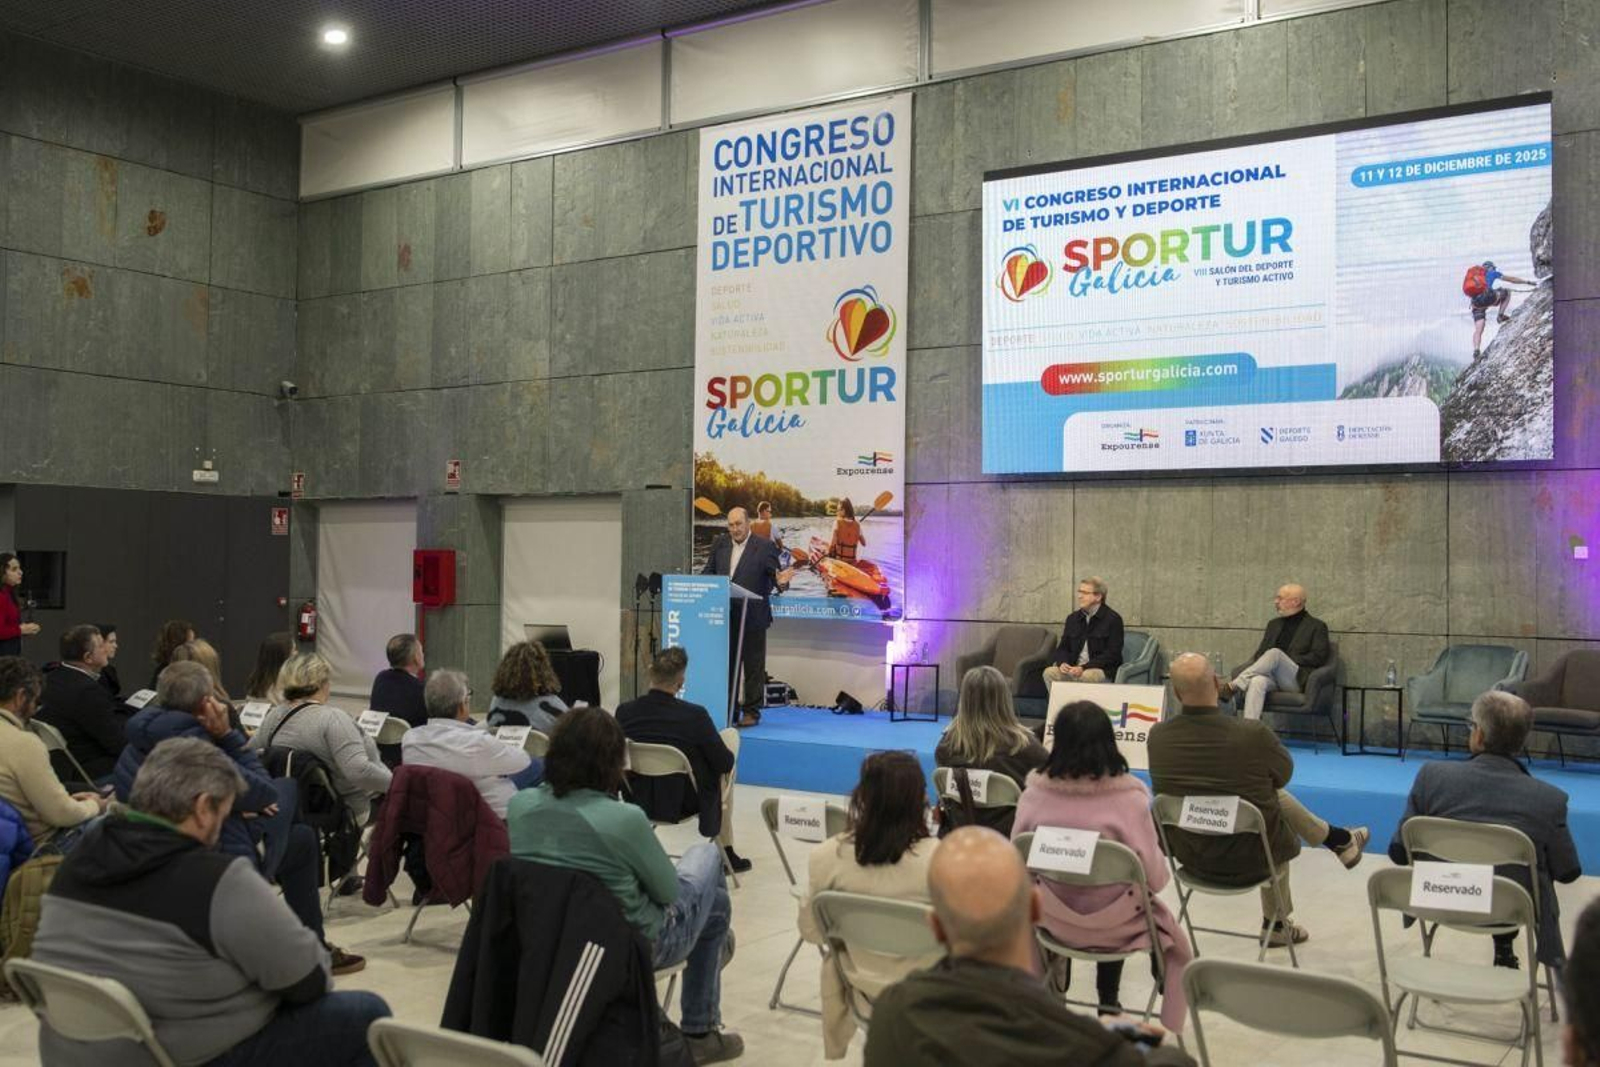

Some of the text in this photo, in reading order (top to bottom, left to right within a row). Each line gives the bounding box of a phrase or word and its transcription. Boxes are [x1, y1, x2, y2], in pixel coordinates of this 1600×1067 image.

[714, 112, 895, 171] CONGRESO
[713, 151, 893, 198] INTERNACIONAL
[1359, 148, 1547, 182] 11 Y 12 DE DICIEMBRE DE 2025
[1002, 163, 1286, 212] VI CONGRESO INTERNACIONAL
[713, 180, 893, 236] DE TURISMO
[1002, 194, 1221, 233] DE TURISMO Y DEPORTE
[712, 220, 892, 271] DEPORTIVO
[1062, 217, 1293, 274] SPORTUR
[1069, 261, 1181, 298] Galicia
[1209, 264, 1236, 275] SALÓN
[1238, 264, 1253, 272] DEL
[1256, 260, 1294, 271] DEPORTE
[1215, 271, 1294, 286] Y TURISMO ACTIVO
[991, 333, 1034, 347] DEPORTE
[1058, 362, 1238, 386] www.sporturgalicia.com
[706, 366, 896, 410] SPORTUR
[706, 403, 806, 439] Galicia
[1101, 443, 1160, 451] Expourense
[1211, 437, 1241, 445] GALICIA
[836, 467, 894, 476] Expourense
[785, 814, 820, 828] Reservado
[1186, 815, 1228, 828] Padroado
[1188, 803, 1229, 817] Reservado
[1039, 843, 1086, 859] Reservado
[1423, 881, 1482, 896] Reservado
